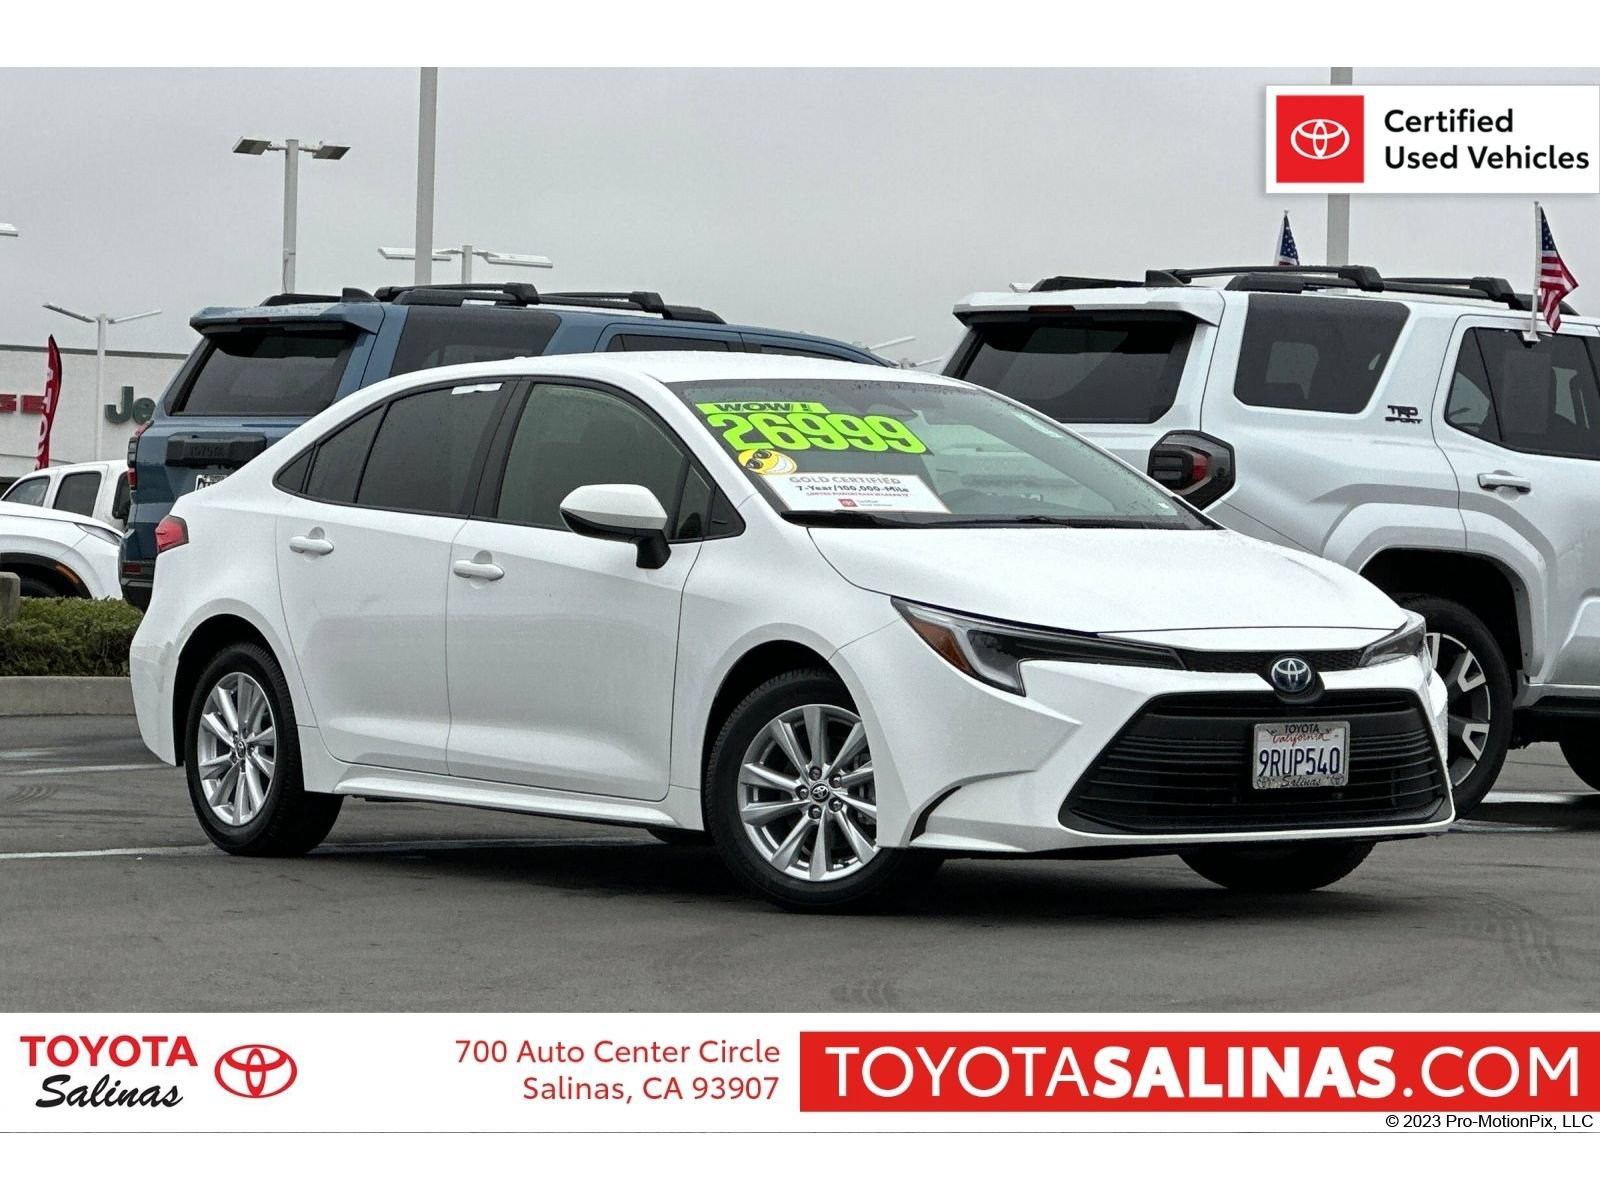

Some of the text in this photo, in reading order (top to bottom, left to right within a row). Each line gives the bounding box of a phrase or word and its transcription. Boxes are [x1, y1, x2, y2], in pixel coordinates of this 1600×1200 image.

[104, 386, 157, 425] Je
[713, 402, 790, 412] WOW
[706, 412, 928, 455] 26999
[831, 477, 902, 485] CERTIFIED
[1284, 723, 1320, 734] TOYOTA
[1272, 732, 1331, 747] California
[1258, 747, 1340, 777] 9RUP540
[1280, 775, 1322, 788] Salinas
